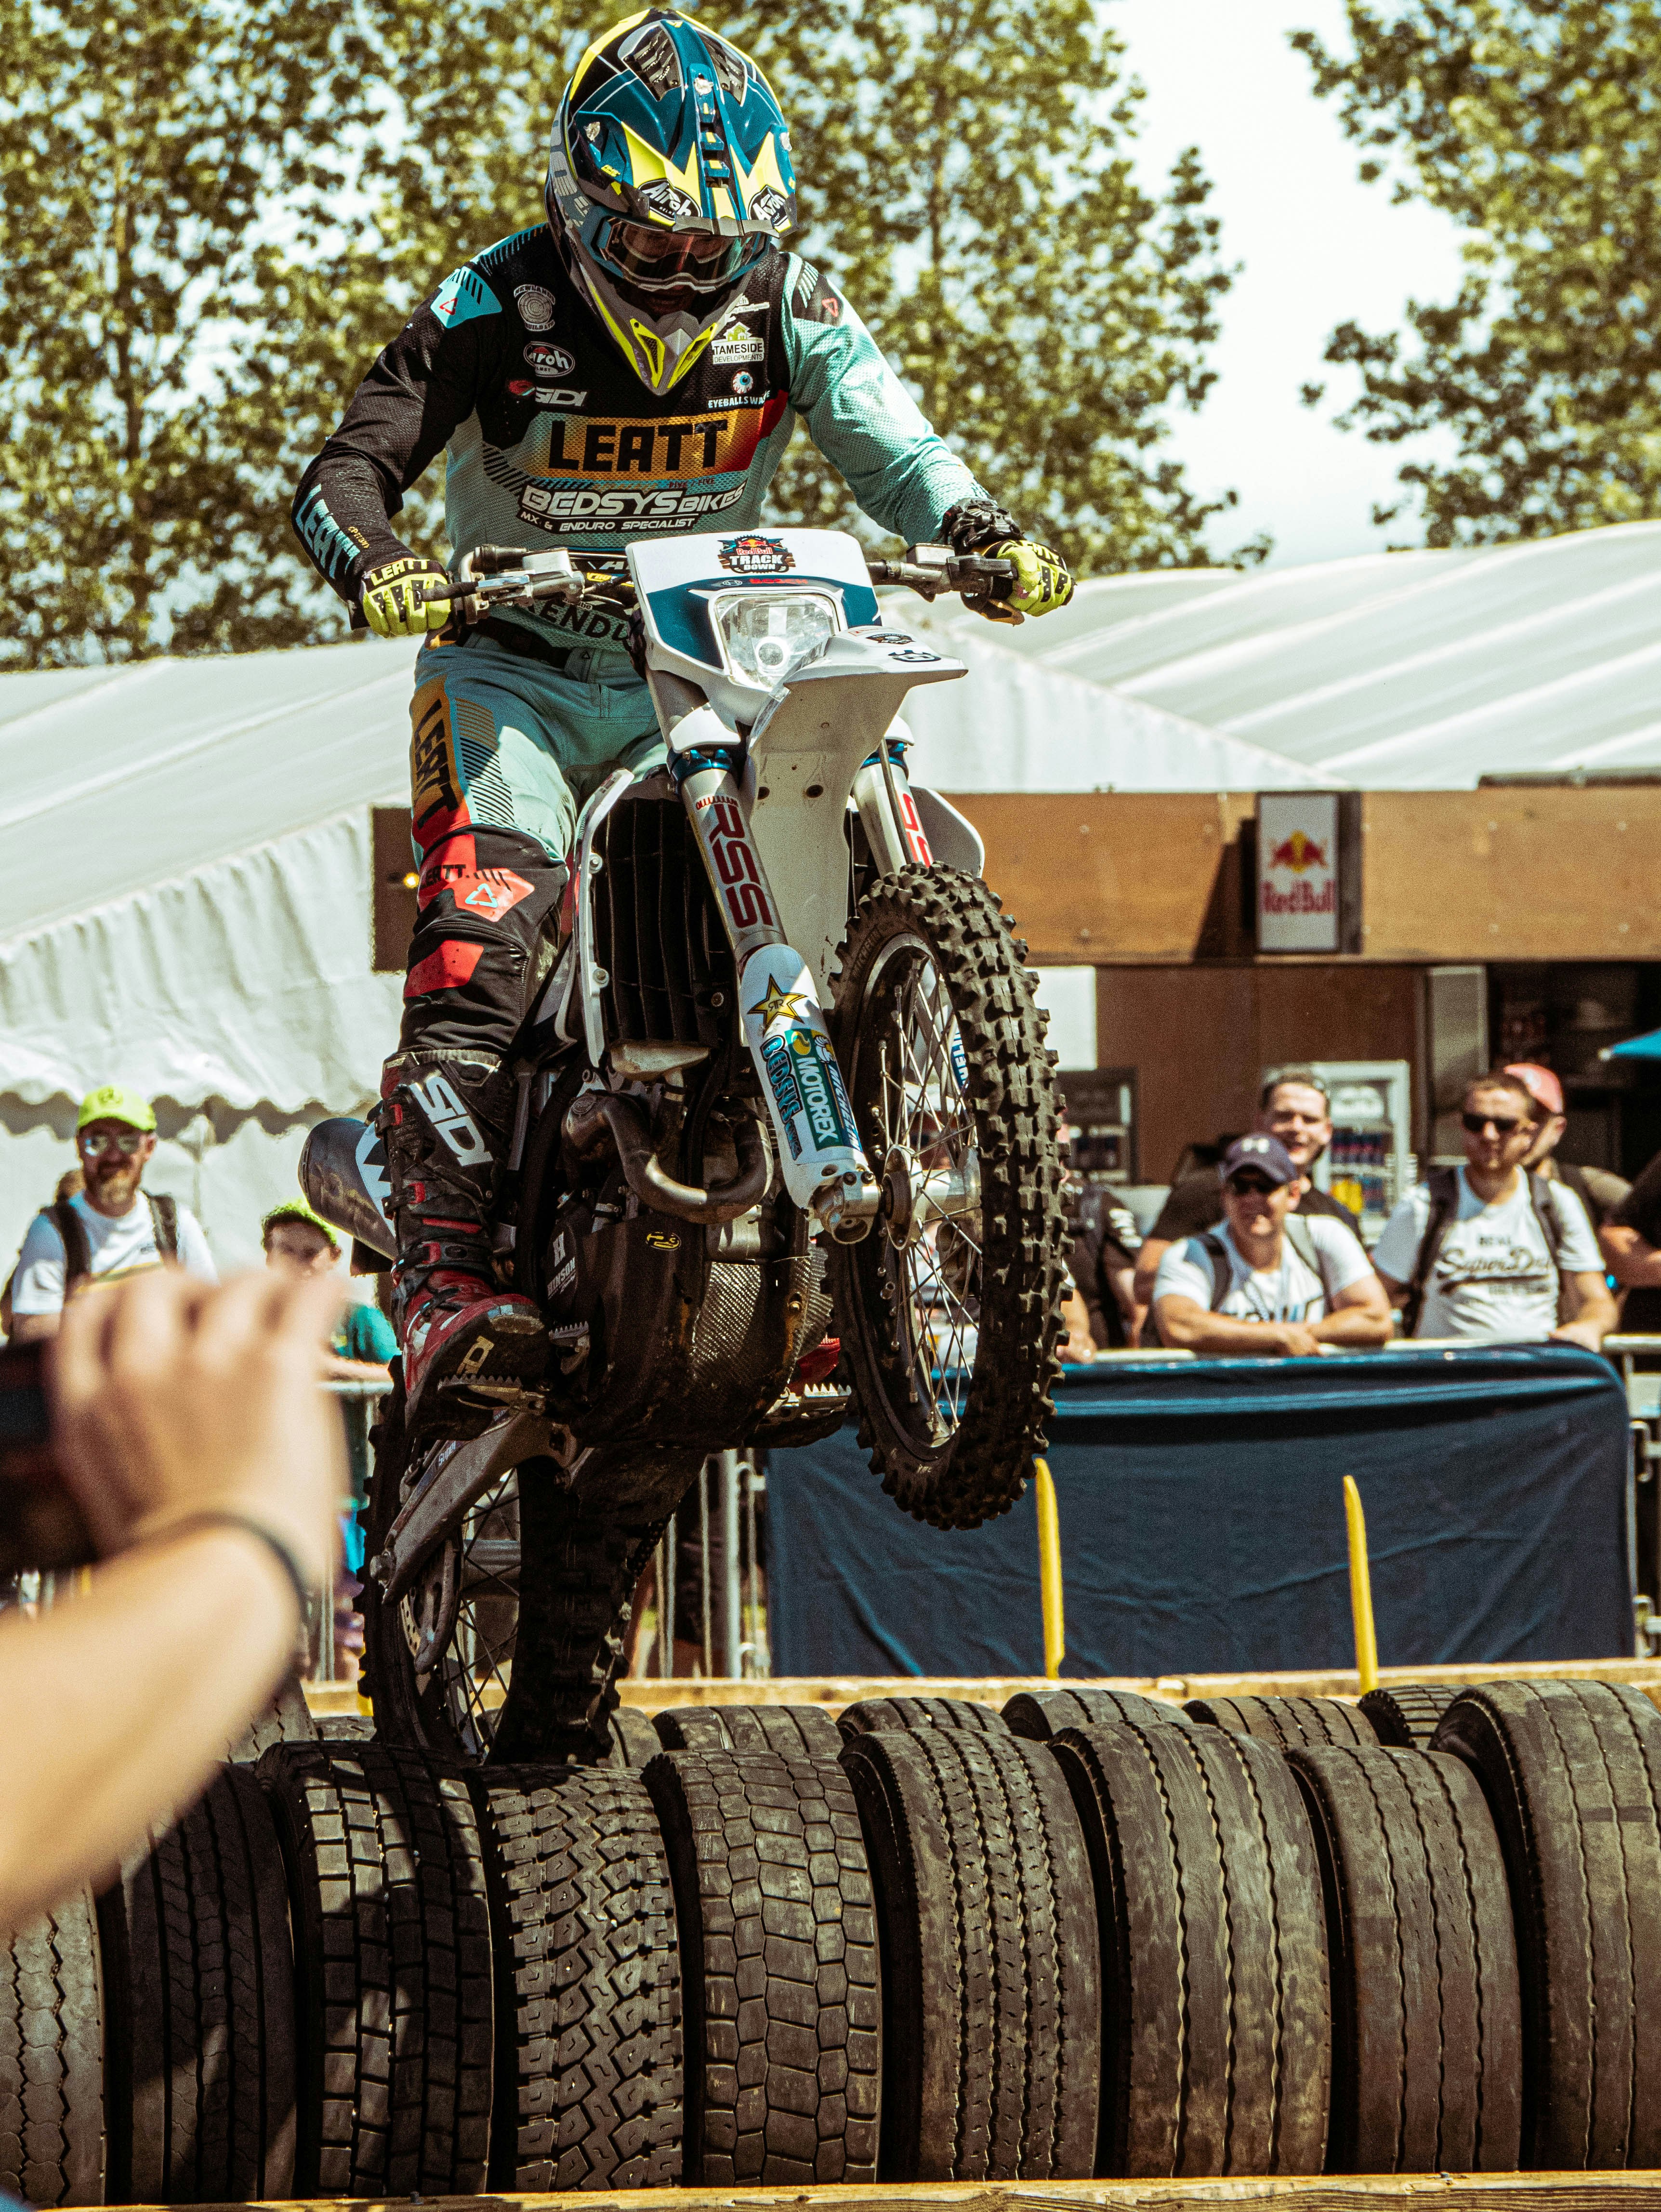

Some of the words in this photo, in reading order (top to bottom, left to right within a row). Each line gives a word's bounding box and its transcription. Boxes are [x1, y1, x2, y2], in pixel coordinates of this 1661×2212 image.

[643, 182, 692, 216] Airoh
[752, 193, 785, 220] Airoh
[714, 342, 764, 355] TAMESIDE
[714, 353, 763, 363] DEVELOPMENTS
[708, 396, 748, 408] EYEBALLS
[548, 419, 728, 472] LEATT
[522, 485, 684, 515] BEDSYS
[678, 483, 746, 513] BIKES
[559, 521, 616, 532] ENDURO
[621, 518, 695, 530] SPECIALIST
[370, 559, 430, 586] LEATT
[729, 554, 783, 566] TRACK
[796, 1057, 839, 1144] MOTOREX
